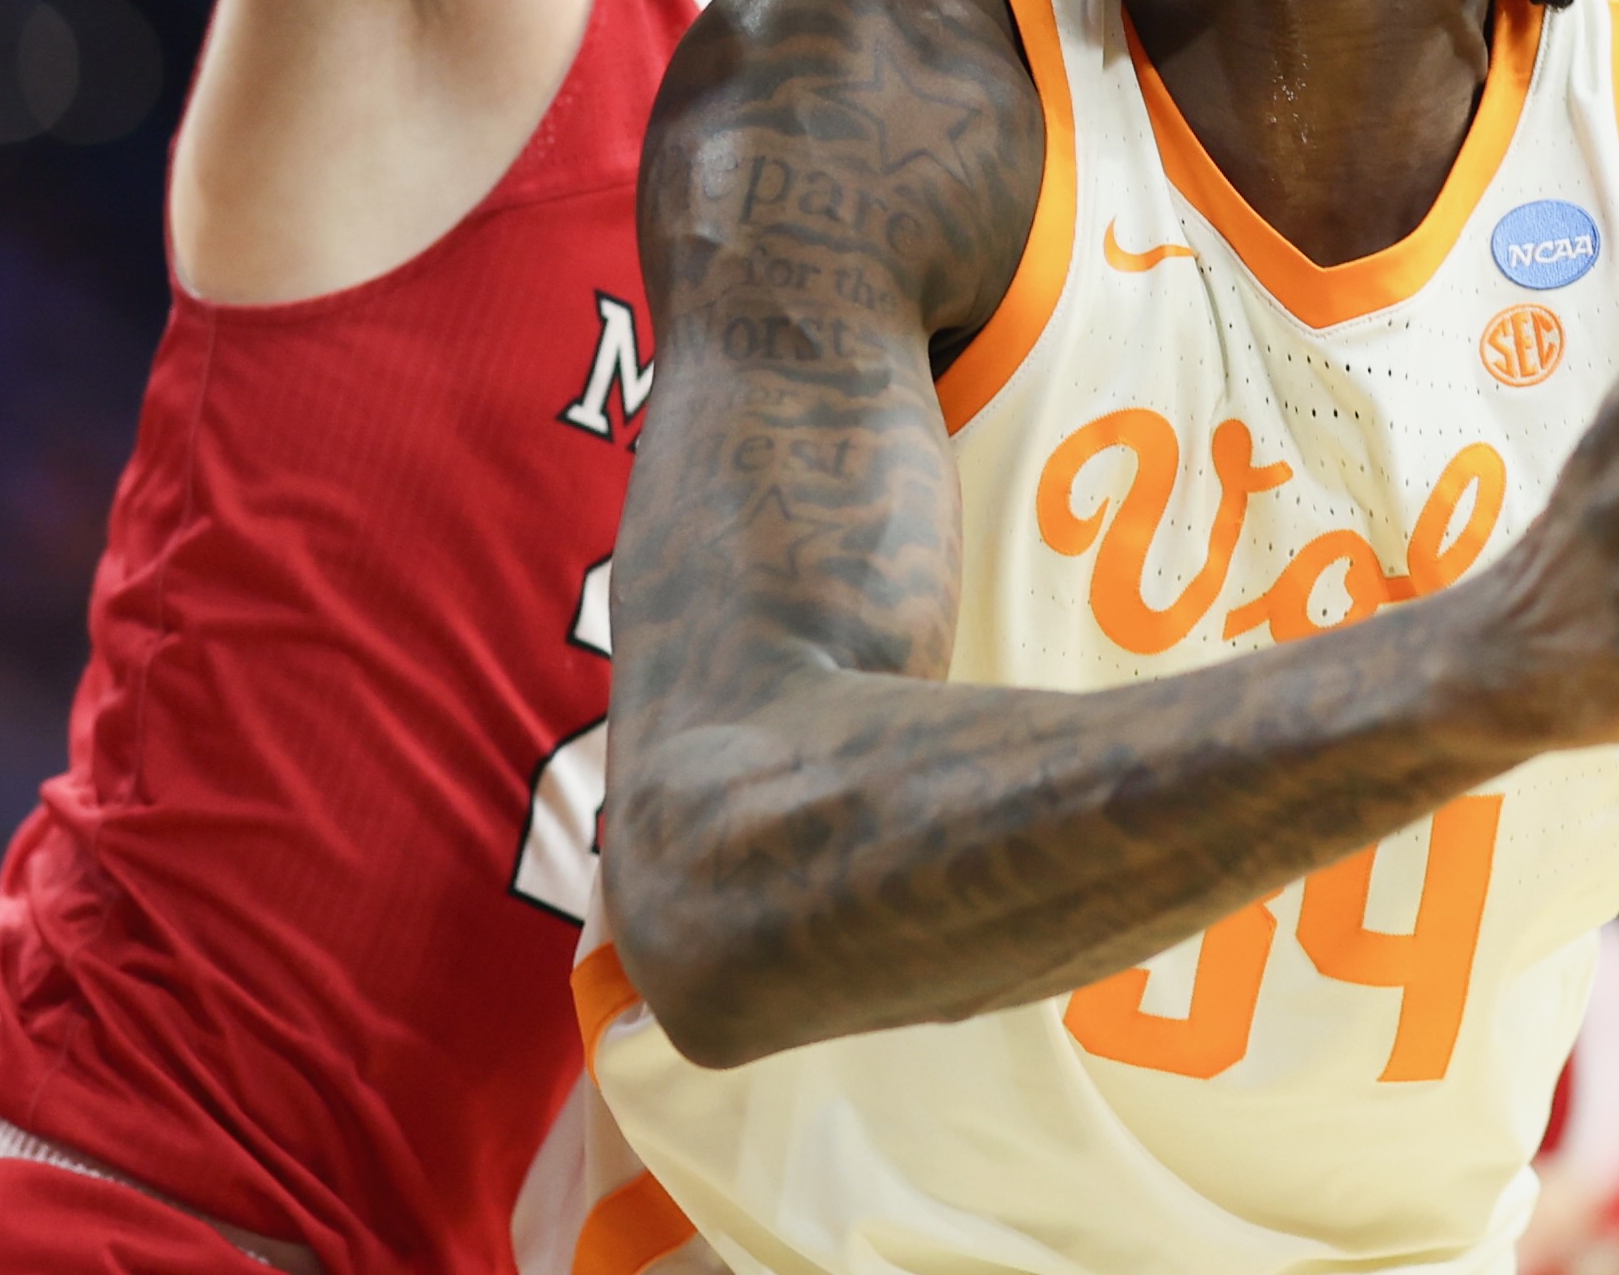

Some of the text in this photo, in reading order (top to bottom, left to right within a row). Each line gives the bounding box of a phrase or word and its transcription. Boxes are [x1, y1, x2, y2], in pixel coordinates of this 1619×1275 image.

[1508, 232, 1594, 268] NCAA
[1487, 311, 1558, 378] SEC
[1036, 407, 1507, 656] Vol
